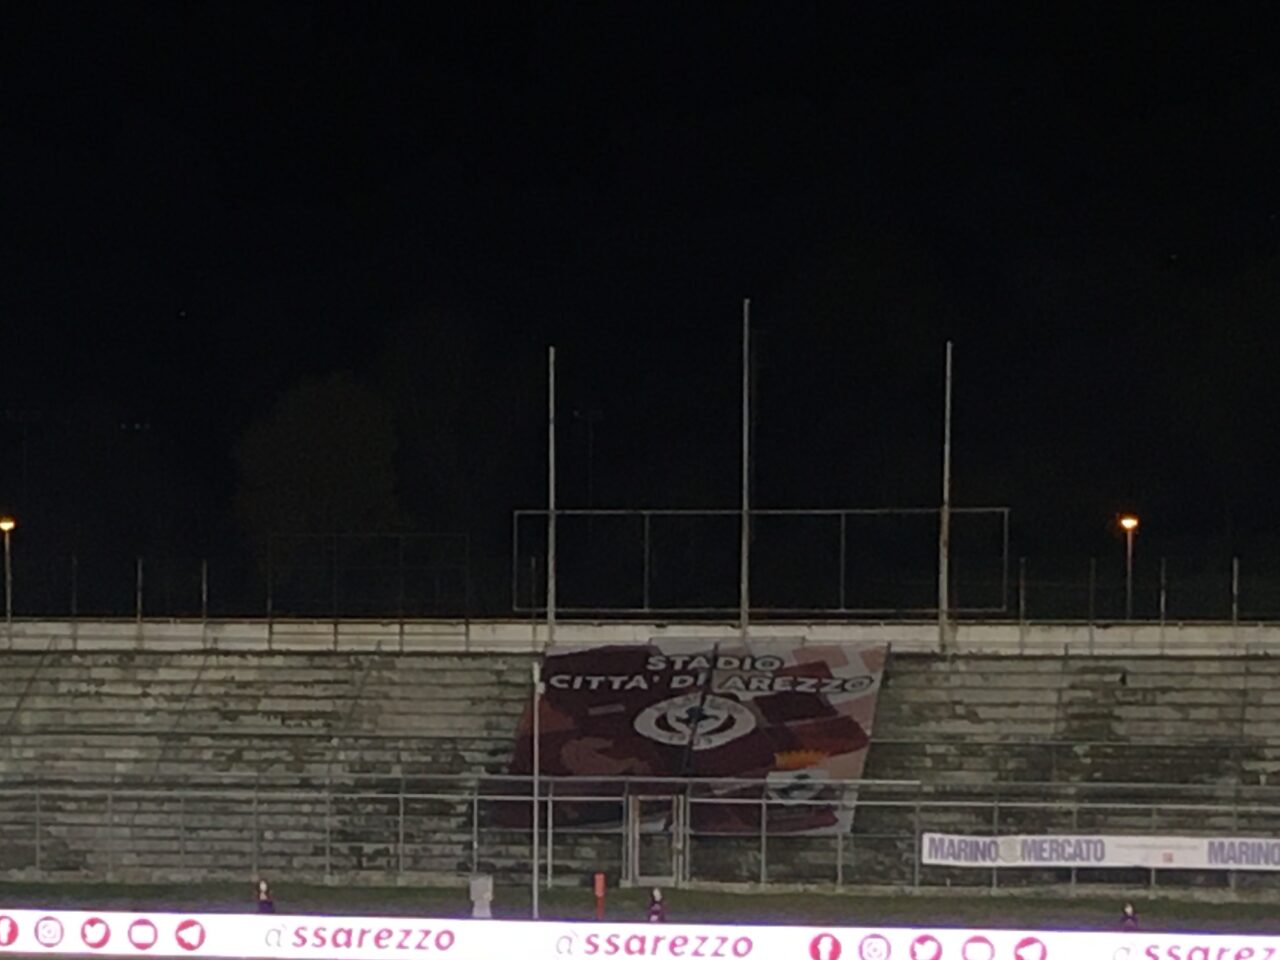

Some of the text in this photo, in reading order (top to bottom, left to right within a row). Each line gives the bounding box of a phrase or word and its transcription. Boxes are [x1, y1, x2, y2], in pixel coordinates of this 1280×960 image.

[646, 654, 785, 672] STADIO
[548, 672, 874, 694] CITTA' DI AREZZO
[927, 836, 1106, 863] MARINO MERCATO
[1207, 840, 1280, 867] MARINO
